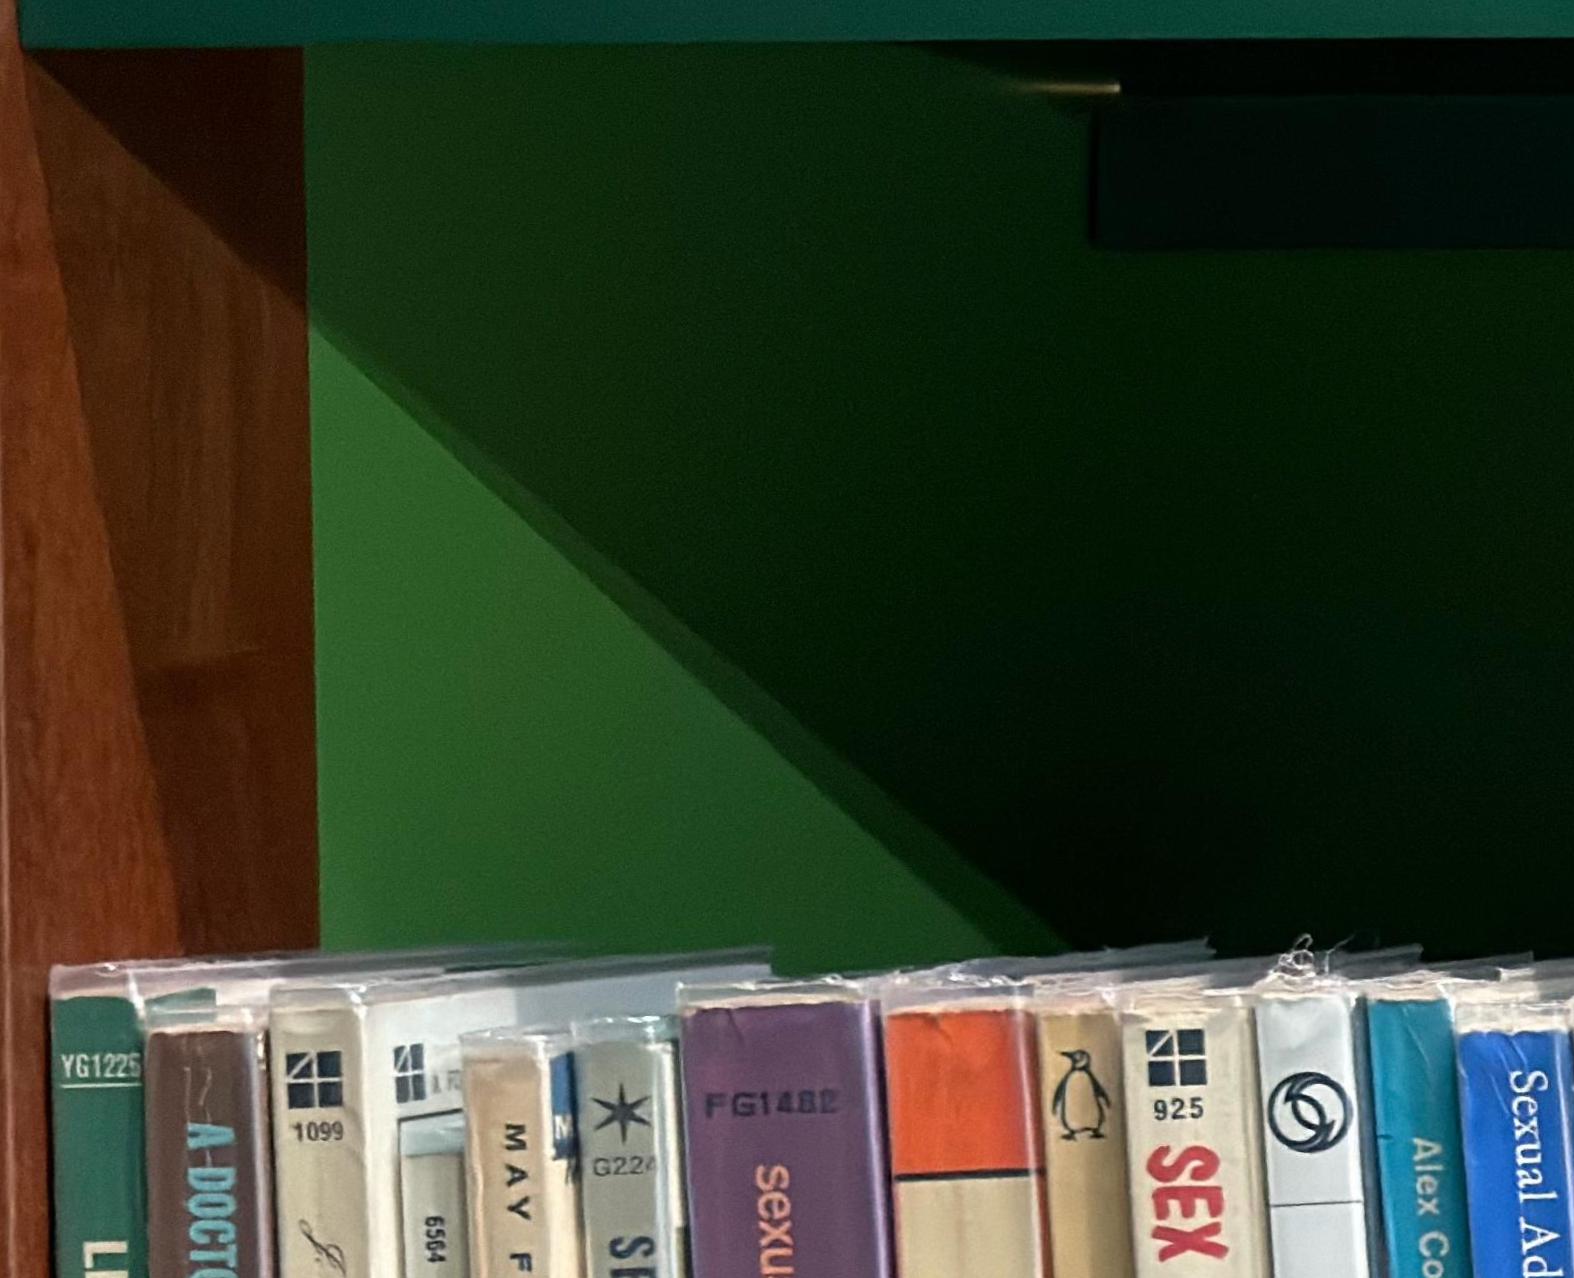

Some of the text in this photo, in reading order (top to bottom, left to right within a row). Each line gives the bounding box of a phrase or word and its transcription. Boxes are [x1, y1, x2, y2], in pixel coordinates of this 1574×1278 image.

[61, 1053, 141, 1078] YG1225
[1153, 1098, 1204, 1121] 925
[293, 1121, 344, 1142] 1099
[504, 1122, 530, 1221] MAY
[1147, 1144, 1230, 1262] SEX
[423, 1214, 446, 1263] 6564
